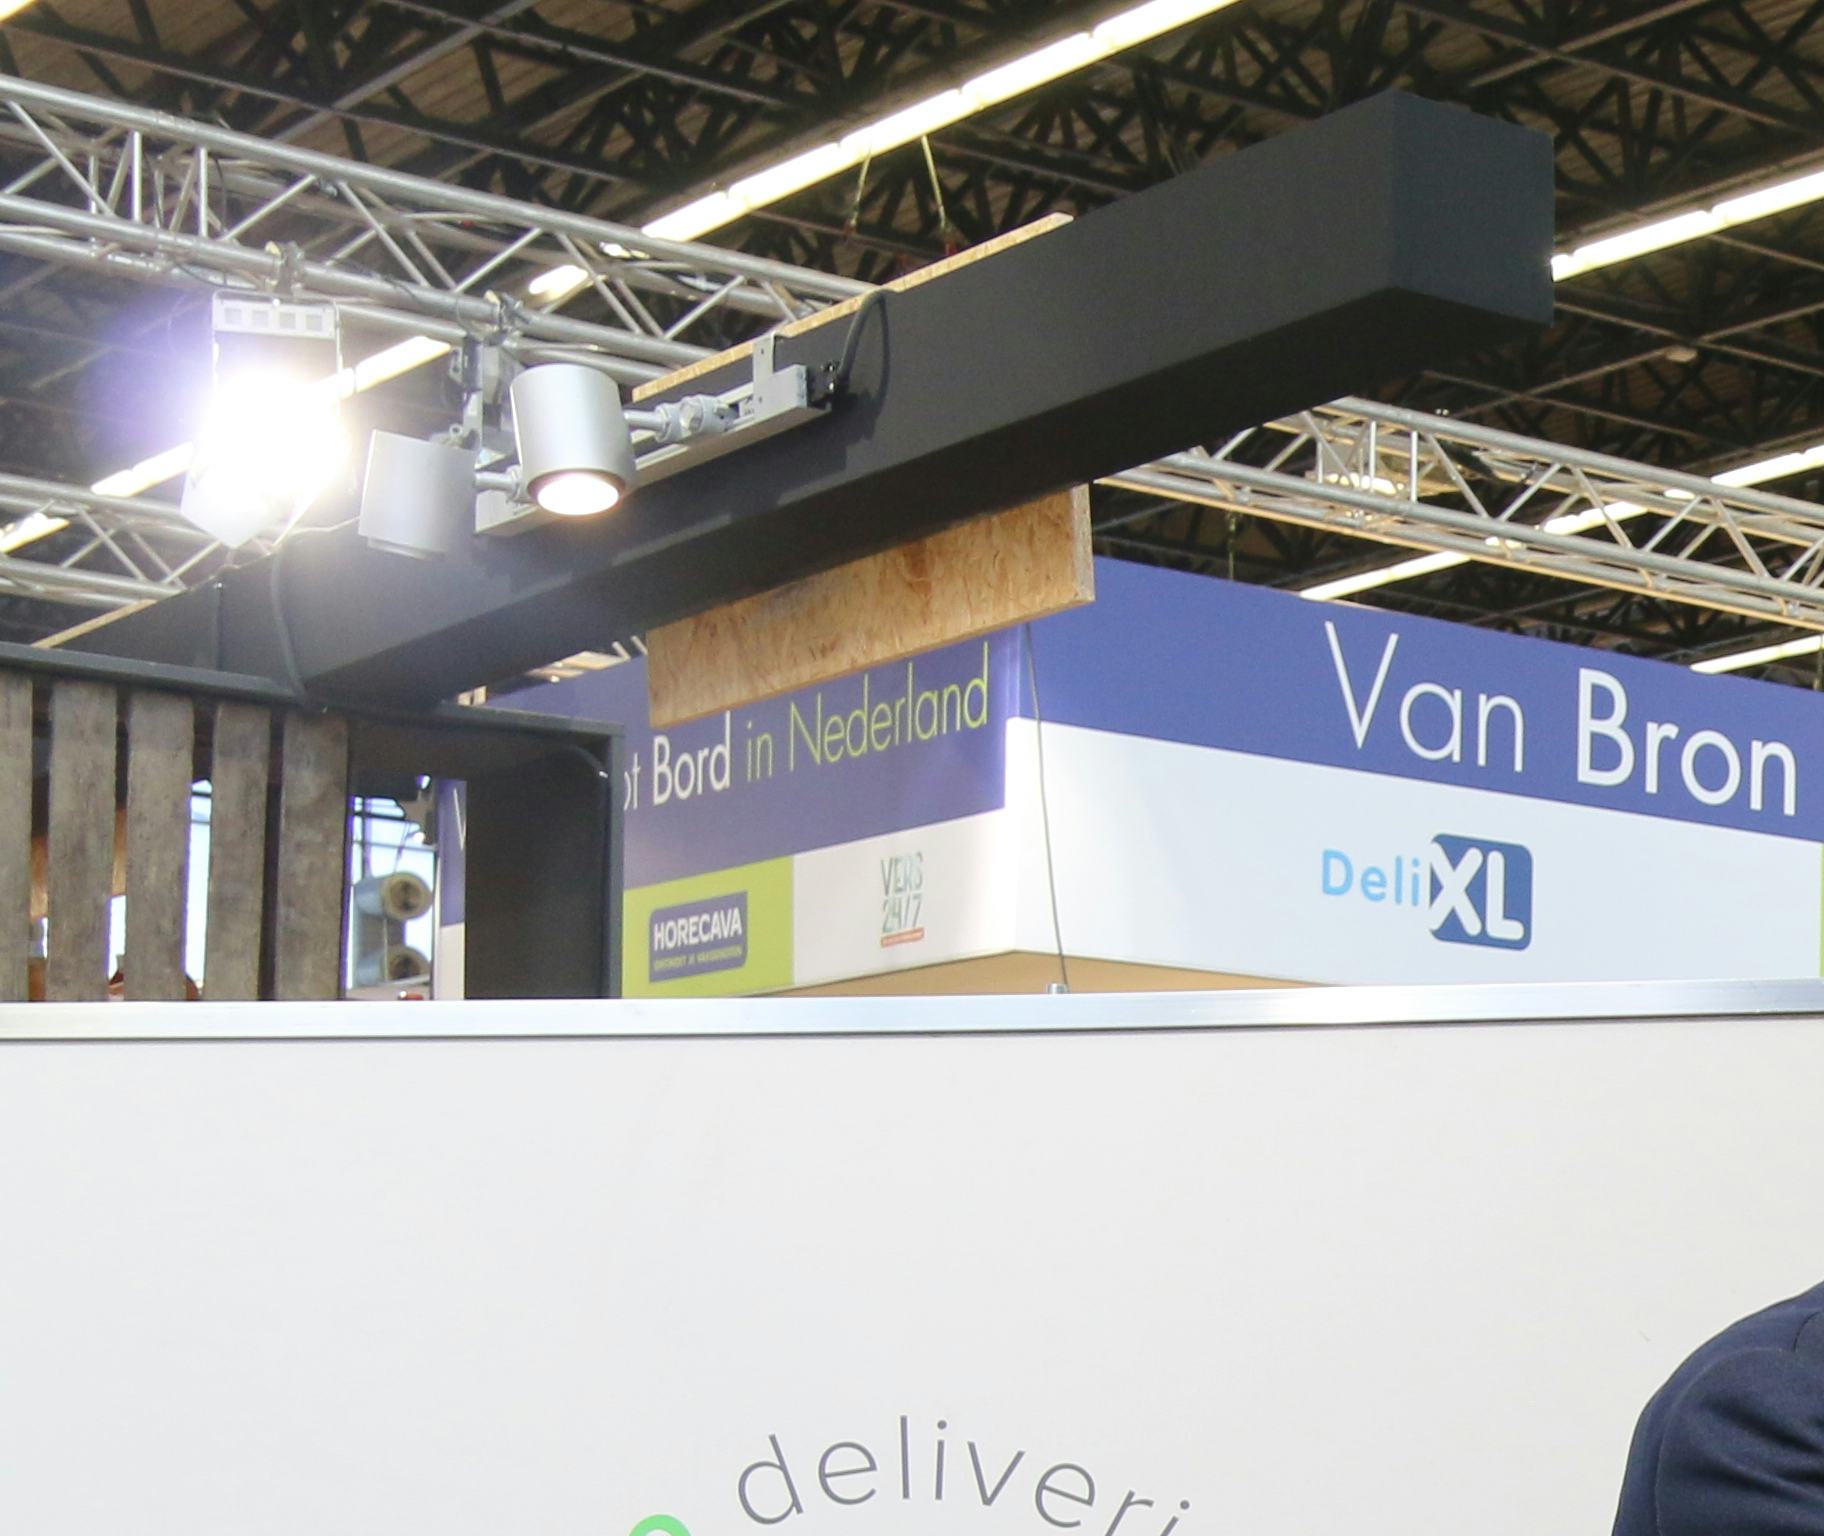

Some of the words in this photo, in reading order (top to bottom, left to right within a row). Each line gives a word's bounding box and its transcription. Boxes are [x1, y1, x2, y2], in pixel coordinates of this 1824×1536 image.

[653, 710, 732, 806] Bord
[746, 720, 773, 782] in
[790, 641, 989, 773] Nederland
[1325, 621, 1524, 773] Van
[1577, 668, 1796, 816] Bron
[881, 850, 924, 897] VERS
[1321, 841, 1526, 941] DeliXL
[653, 906, 743, 952] HORECAVA
[882, 892, 922, 933] 24/7
